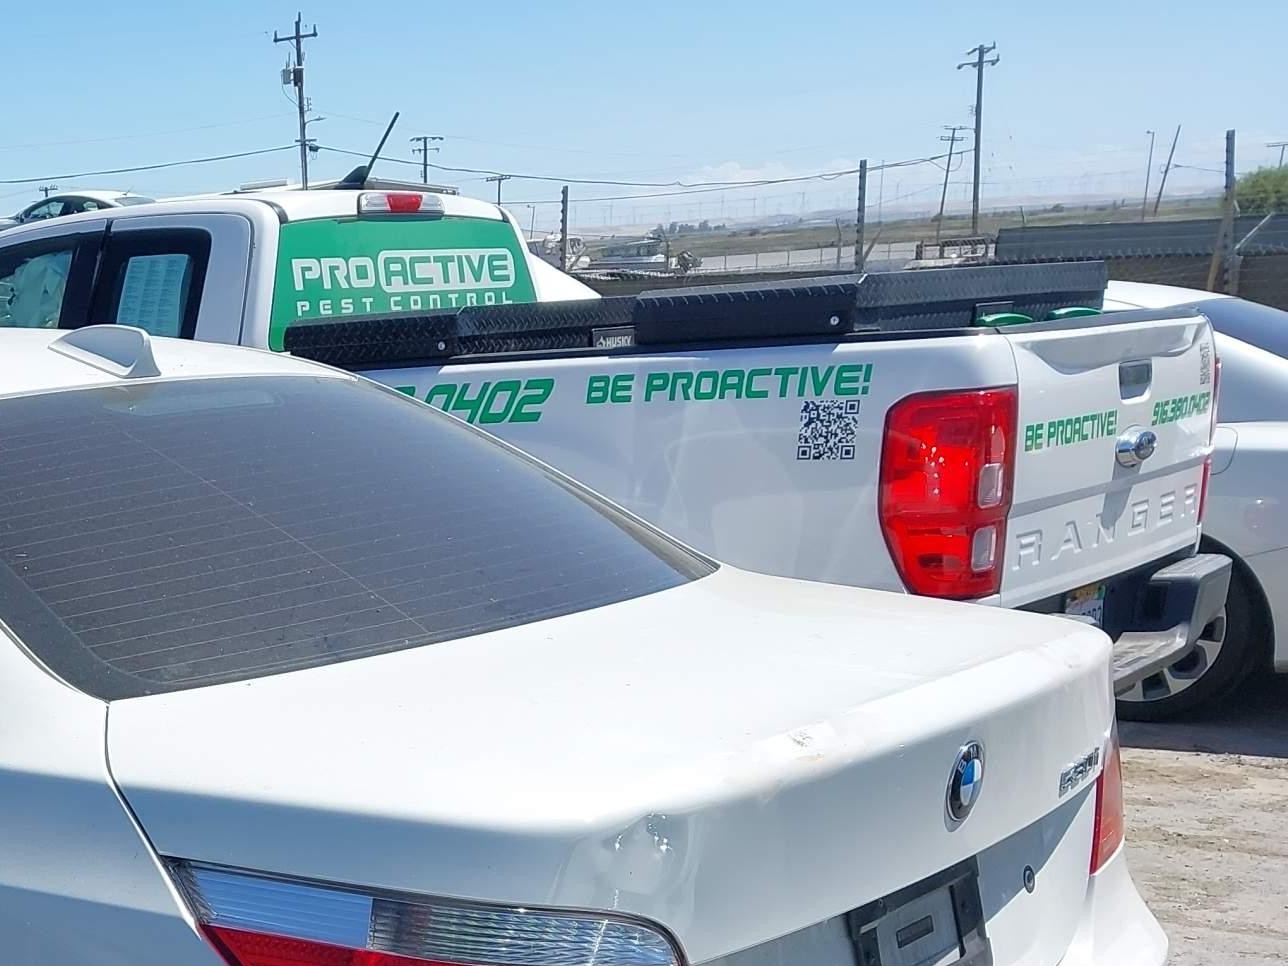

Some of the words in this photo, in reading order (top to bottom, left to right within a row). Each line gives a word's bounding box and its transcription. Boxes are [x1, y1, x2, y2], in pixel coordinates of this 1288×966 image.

[297, 297, 374, 317] PEST
[390, 291, 513, 312] CONTROL
[606, 335, 632, 349] HUSKY
[585, 373, 635, 404] BE
[644, 363, 873, 402] PROACTIVE!
[1024, 422, 1044, 452] BE
[1046, 409, 1118, 447] PROACTIVE!
[1012, 483, 1198, 570] RANGER
